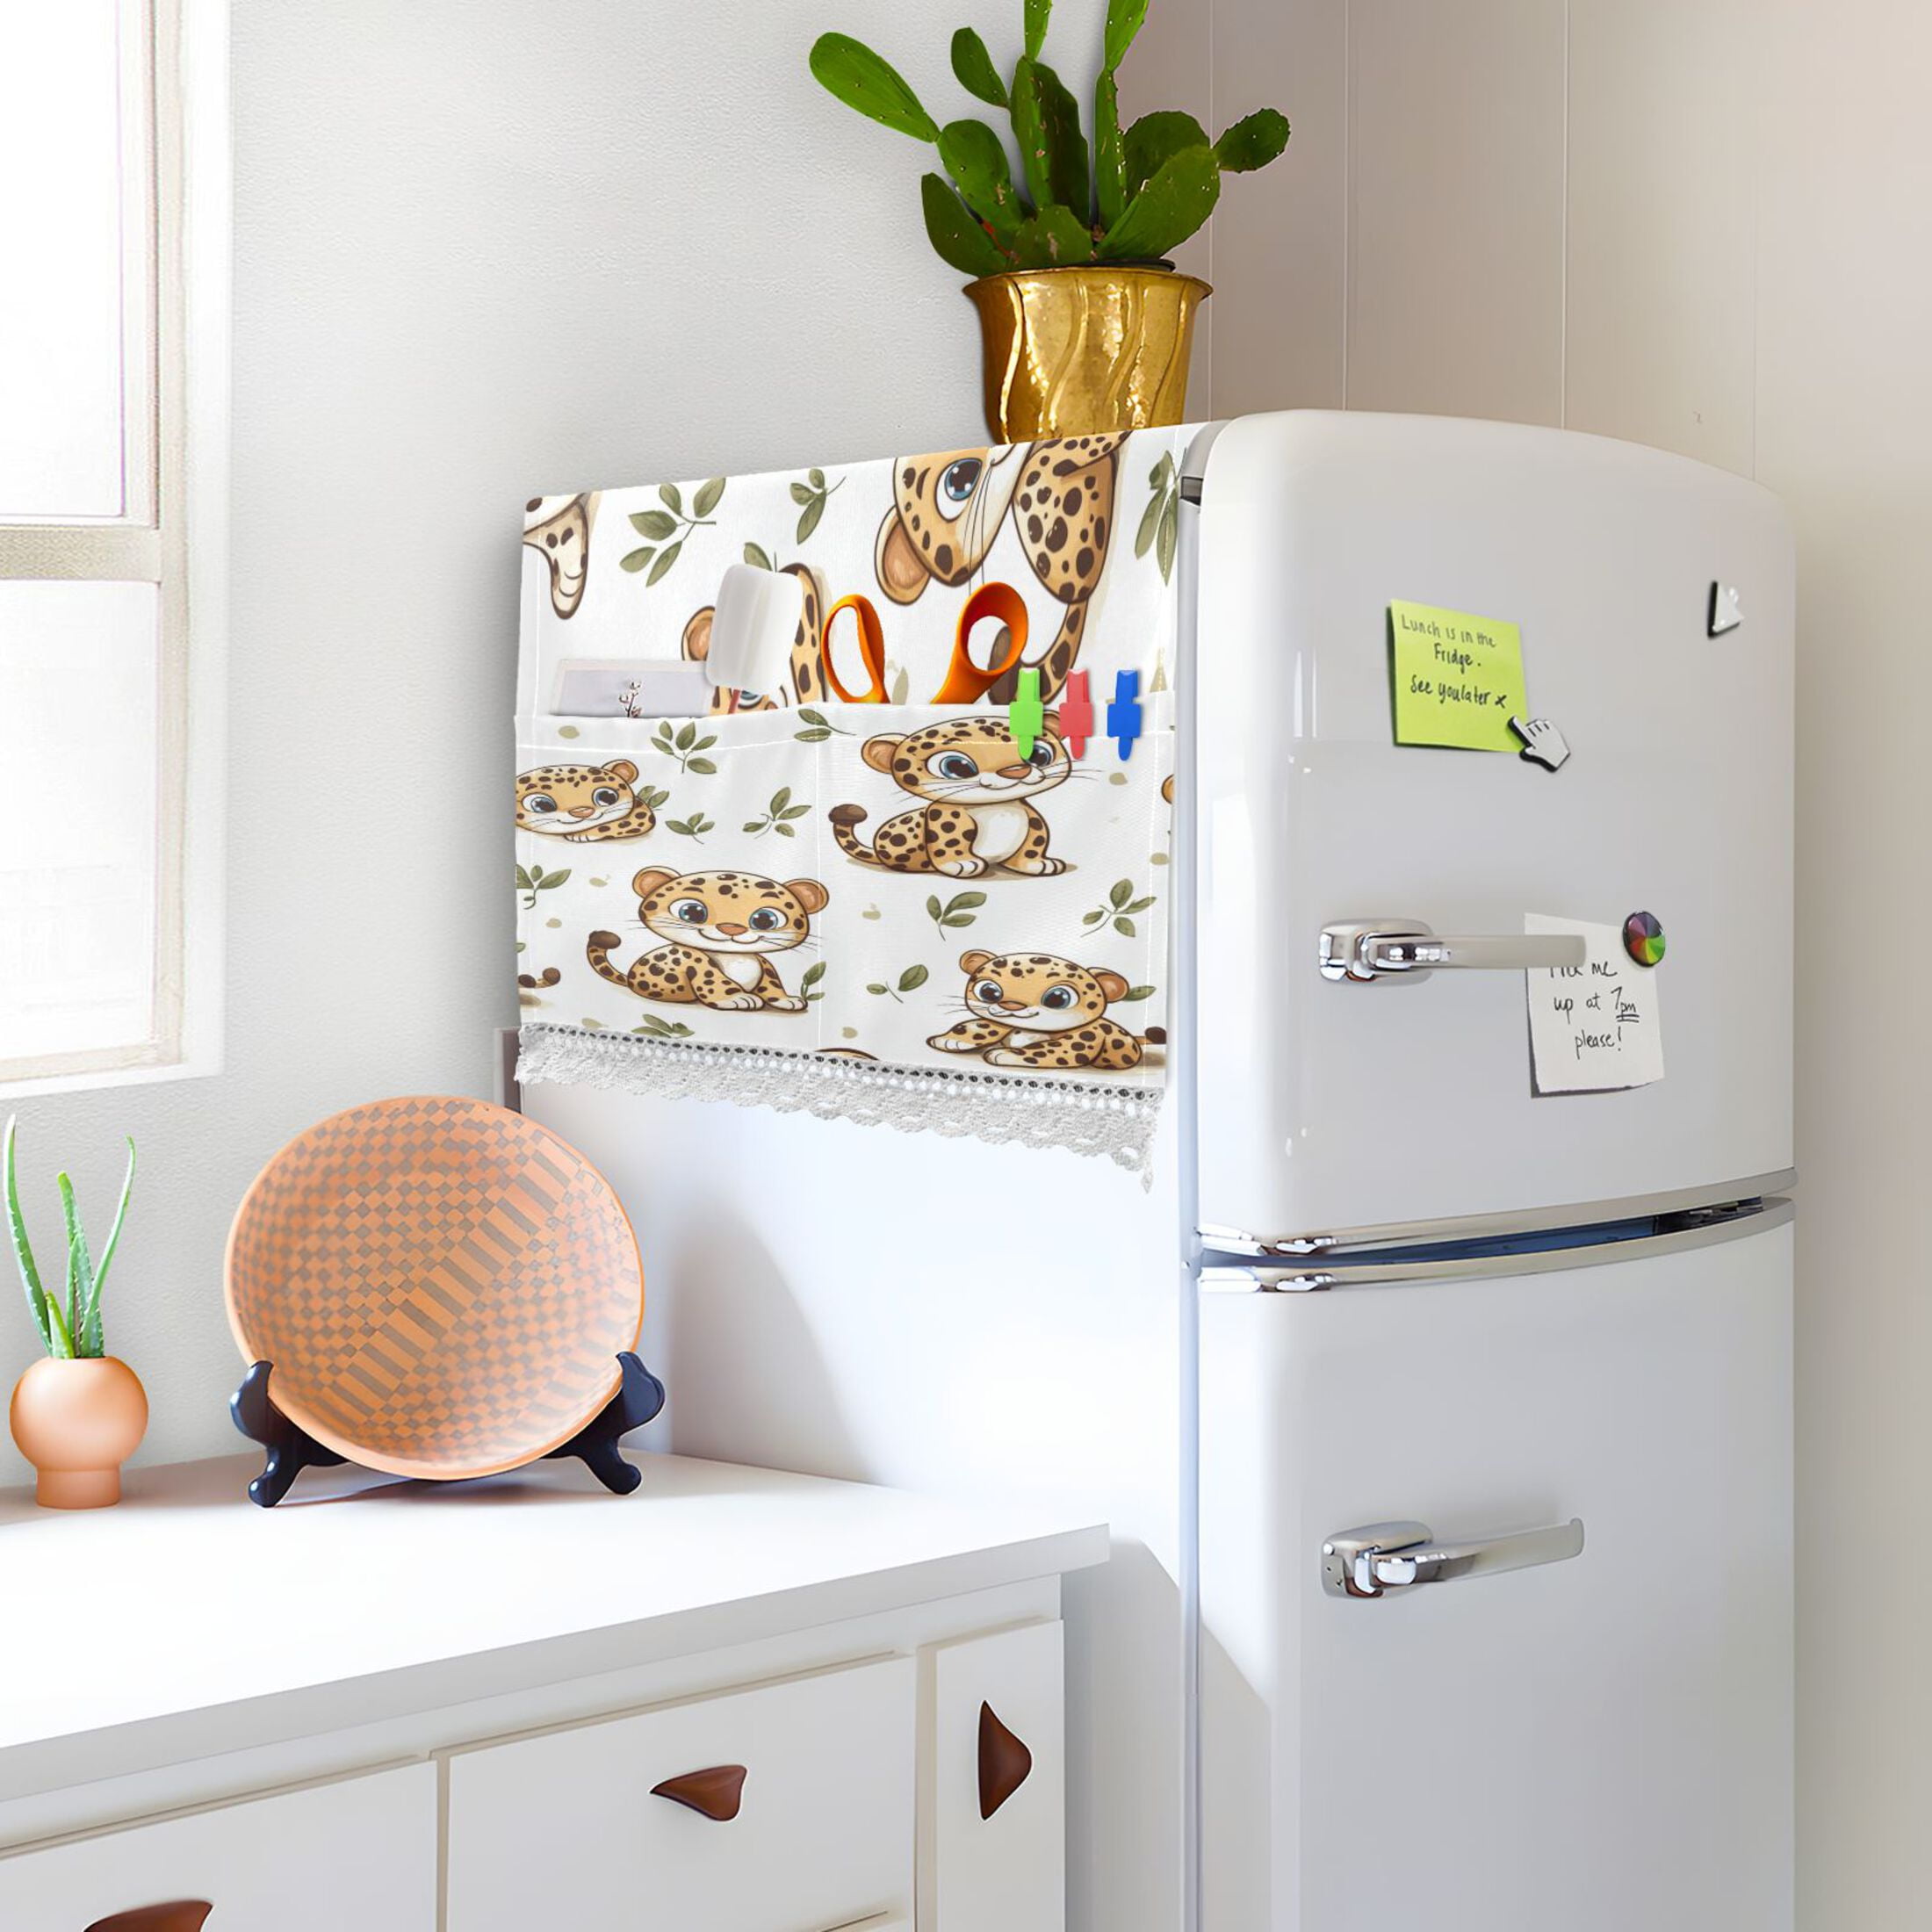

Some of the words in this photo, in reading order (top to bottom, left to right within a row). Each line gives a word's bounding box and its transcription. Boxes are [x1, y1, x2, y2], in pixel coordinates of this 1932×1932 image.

[1402, 613, 1441, 638] Lunch
[1477, 631, 1496, 648] the
[1410, 674, 1433, 695] See
[1554, 996, 1574, 1025] up
[1585, 992, 1601, 1011] at
